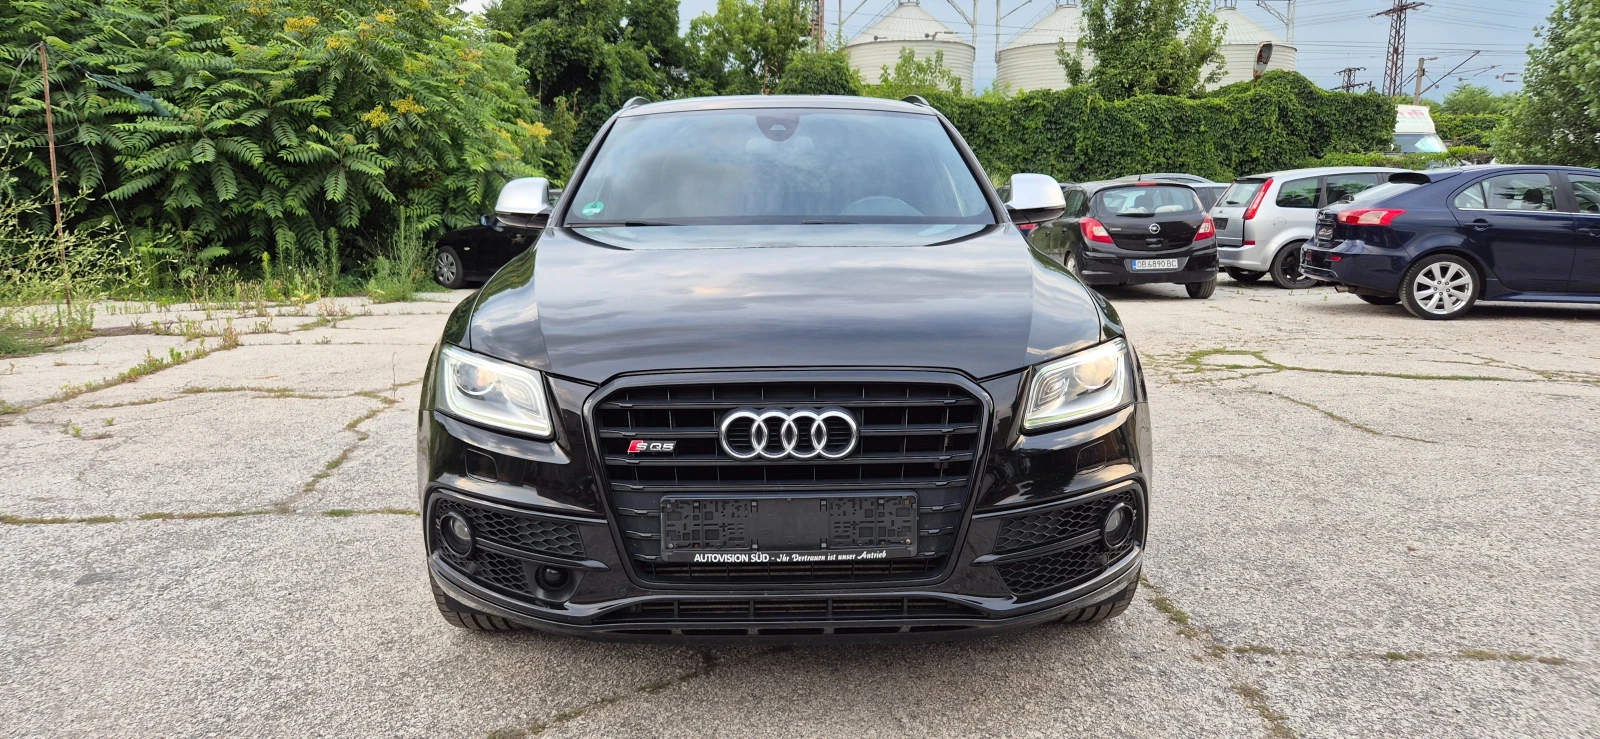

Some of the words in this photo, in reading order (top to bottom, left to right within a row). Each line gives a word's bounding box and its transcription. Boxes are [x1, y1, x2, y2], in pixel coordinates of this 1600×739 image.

[1148, 260, 1166, 268] 6890
[1167, 259, 1177, 267] BC
[694, 553, 749, 562] AUTOVISION
[750, 551, 769, 562] SÜD
[792, 553, 826, 562] Vertrauen
[857, 550, 887, 559] Antrieb
